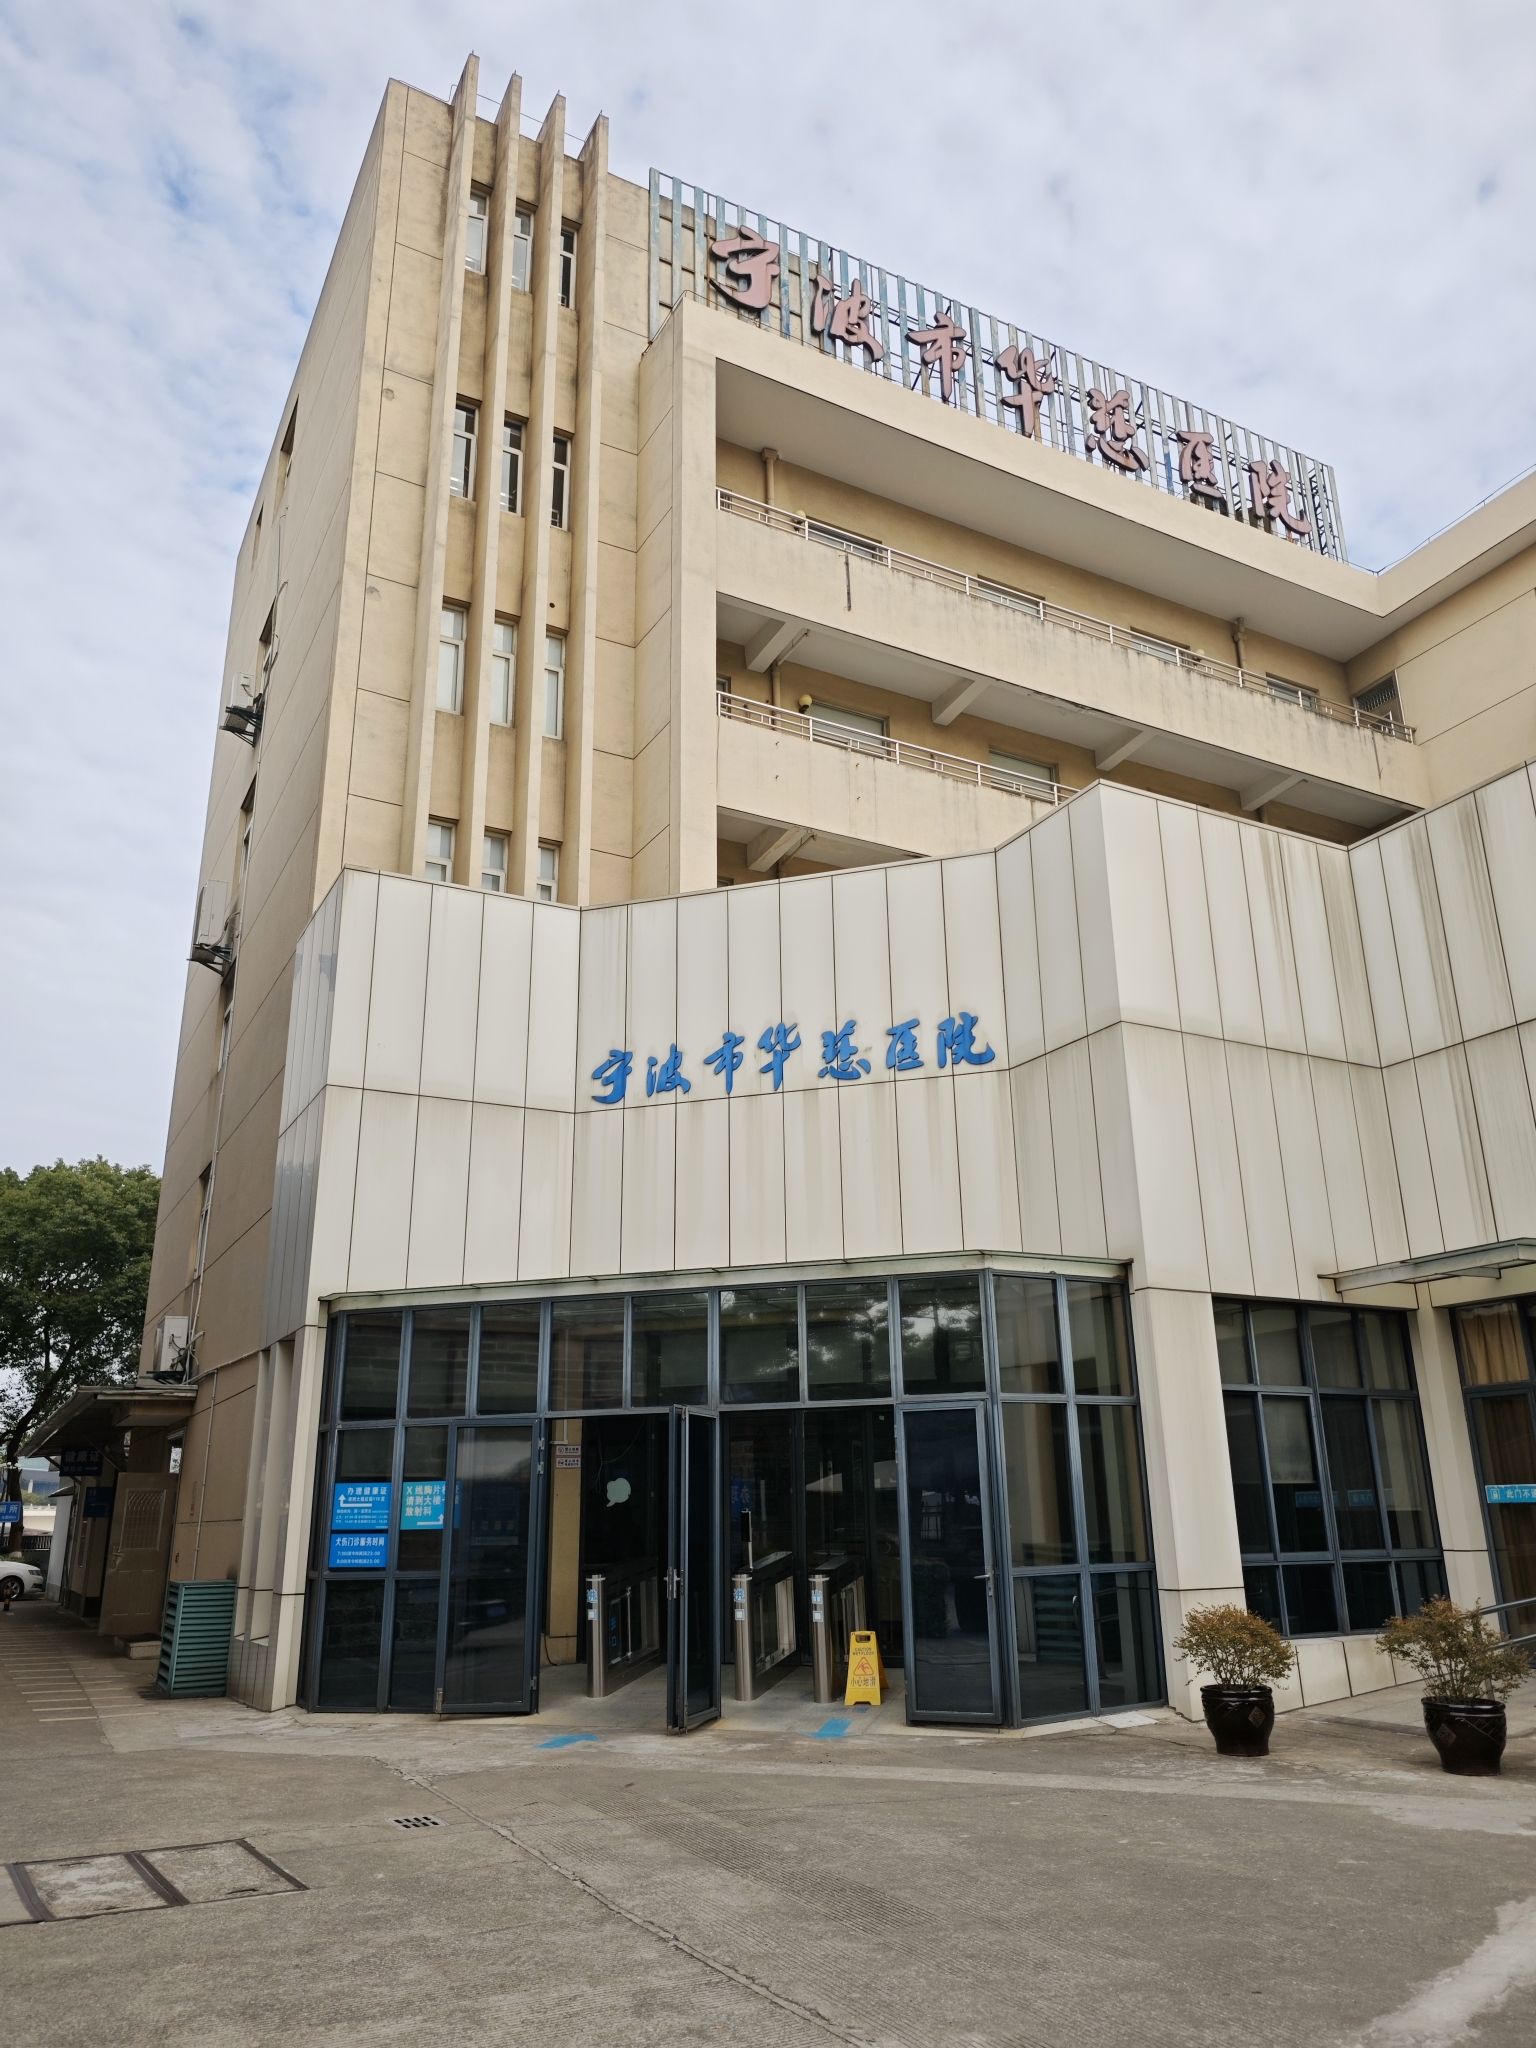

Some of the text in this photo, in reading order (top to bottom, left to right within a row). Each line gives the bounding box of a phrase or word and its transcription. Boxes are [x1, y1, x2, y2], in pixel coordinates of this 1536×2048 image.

[710, 225, 1312, 535] 宁波市华慈医院
[591, 1011, 996, 1105] 宁波市华慈医院
[347, 1487, 387, 1495] 办理健康证
[405, 1506, 432, 1517] 放射科
[335, 1536, 385, 1547] 犬伤门诊服务时间
[851, 1676, 876, 1687] 小心地滑
